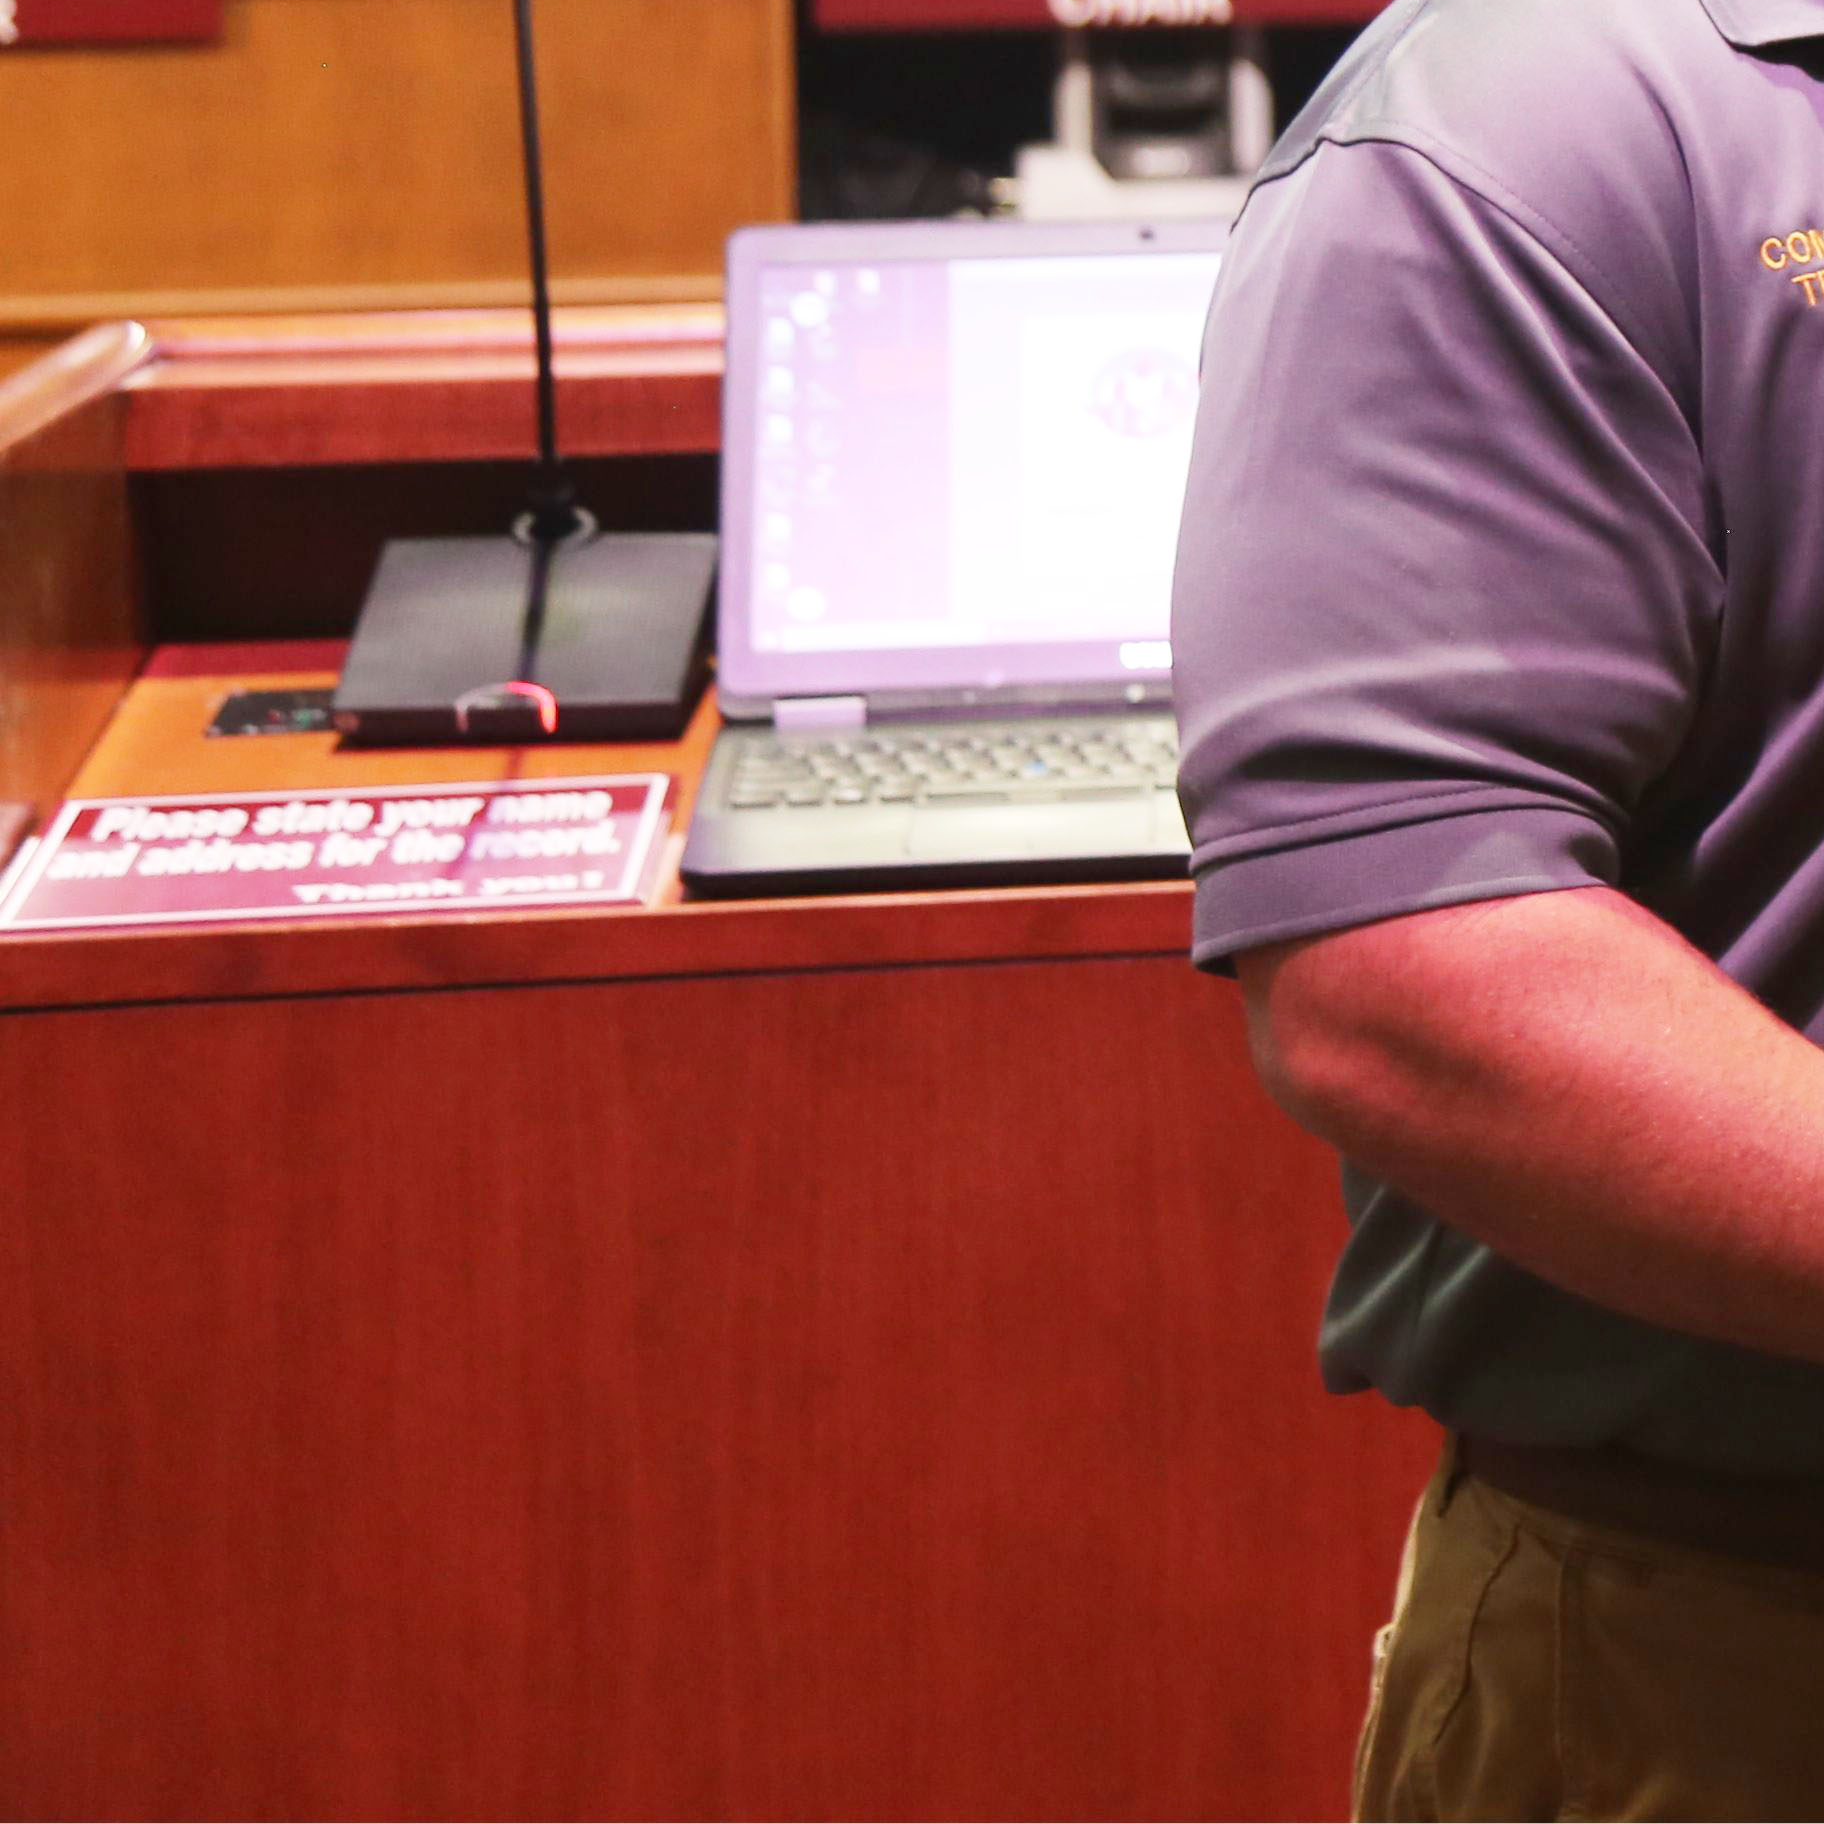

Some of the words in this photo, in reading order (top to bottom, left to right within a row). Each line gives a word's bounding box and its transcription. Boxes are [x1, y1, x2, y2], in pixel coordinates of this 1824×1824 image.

[91, 805, 250, 843] Please
[252, 796, 374, 836] state
[374, 795, 485, 837] your
[486, 790, 612, 824] name
[46, 840, 142, 880] and
[137, 837, 315, 876] address
[317, 831, 388, 869] for
[390, 826, 466, 865] the
